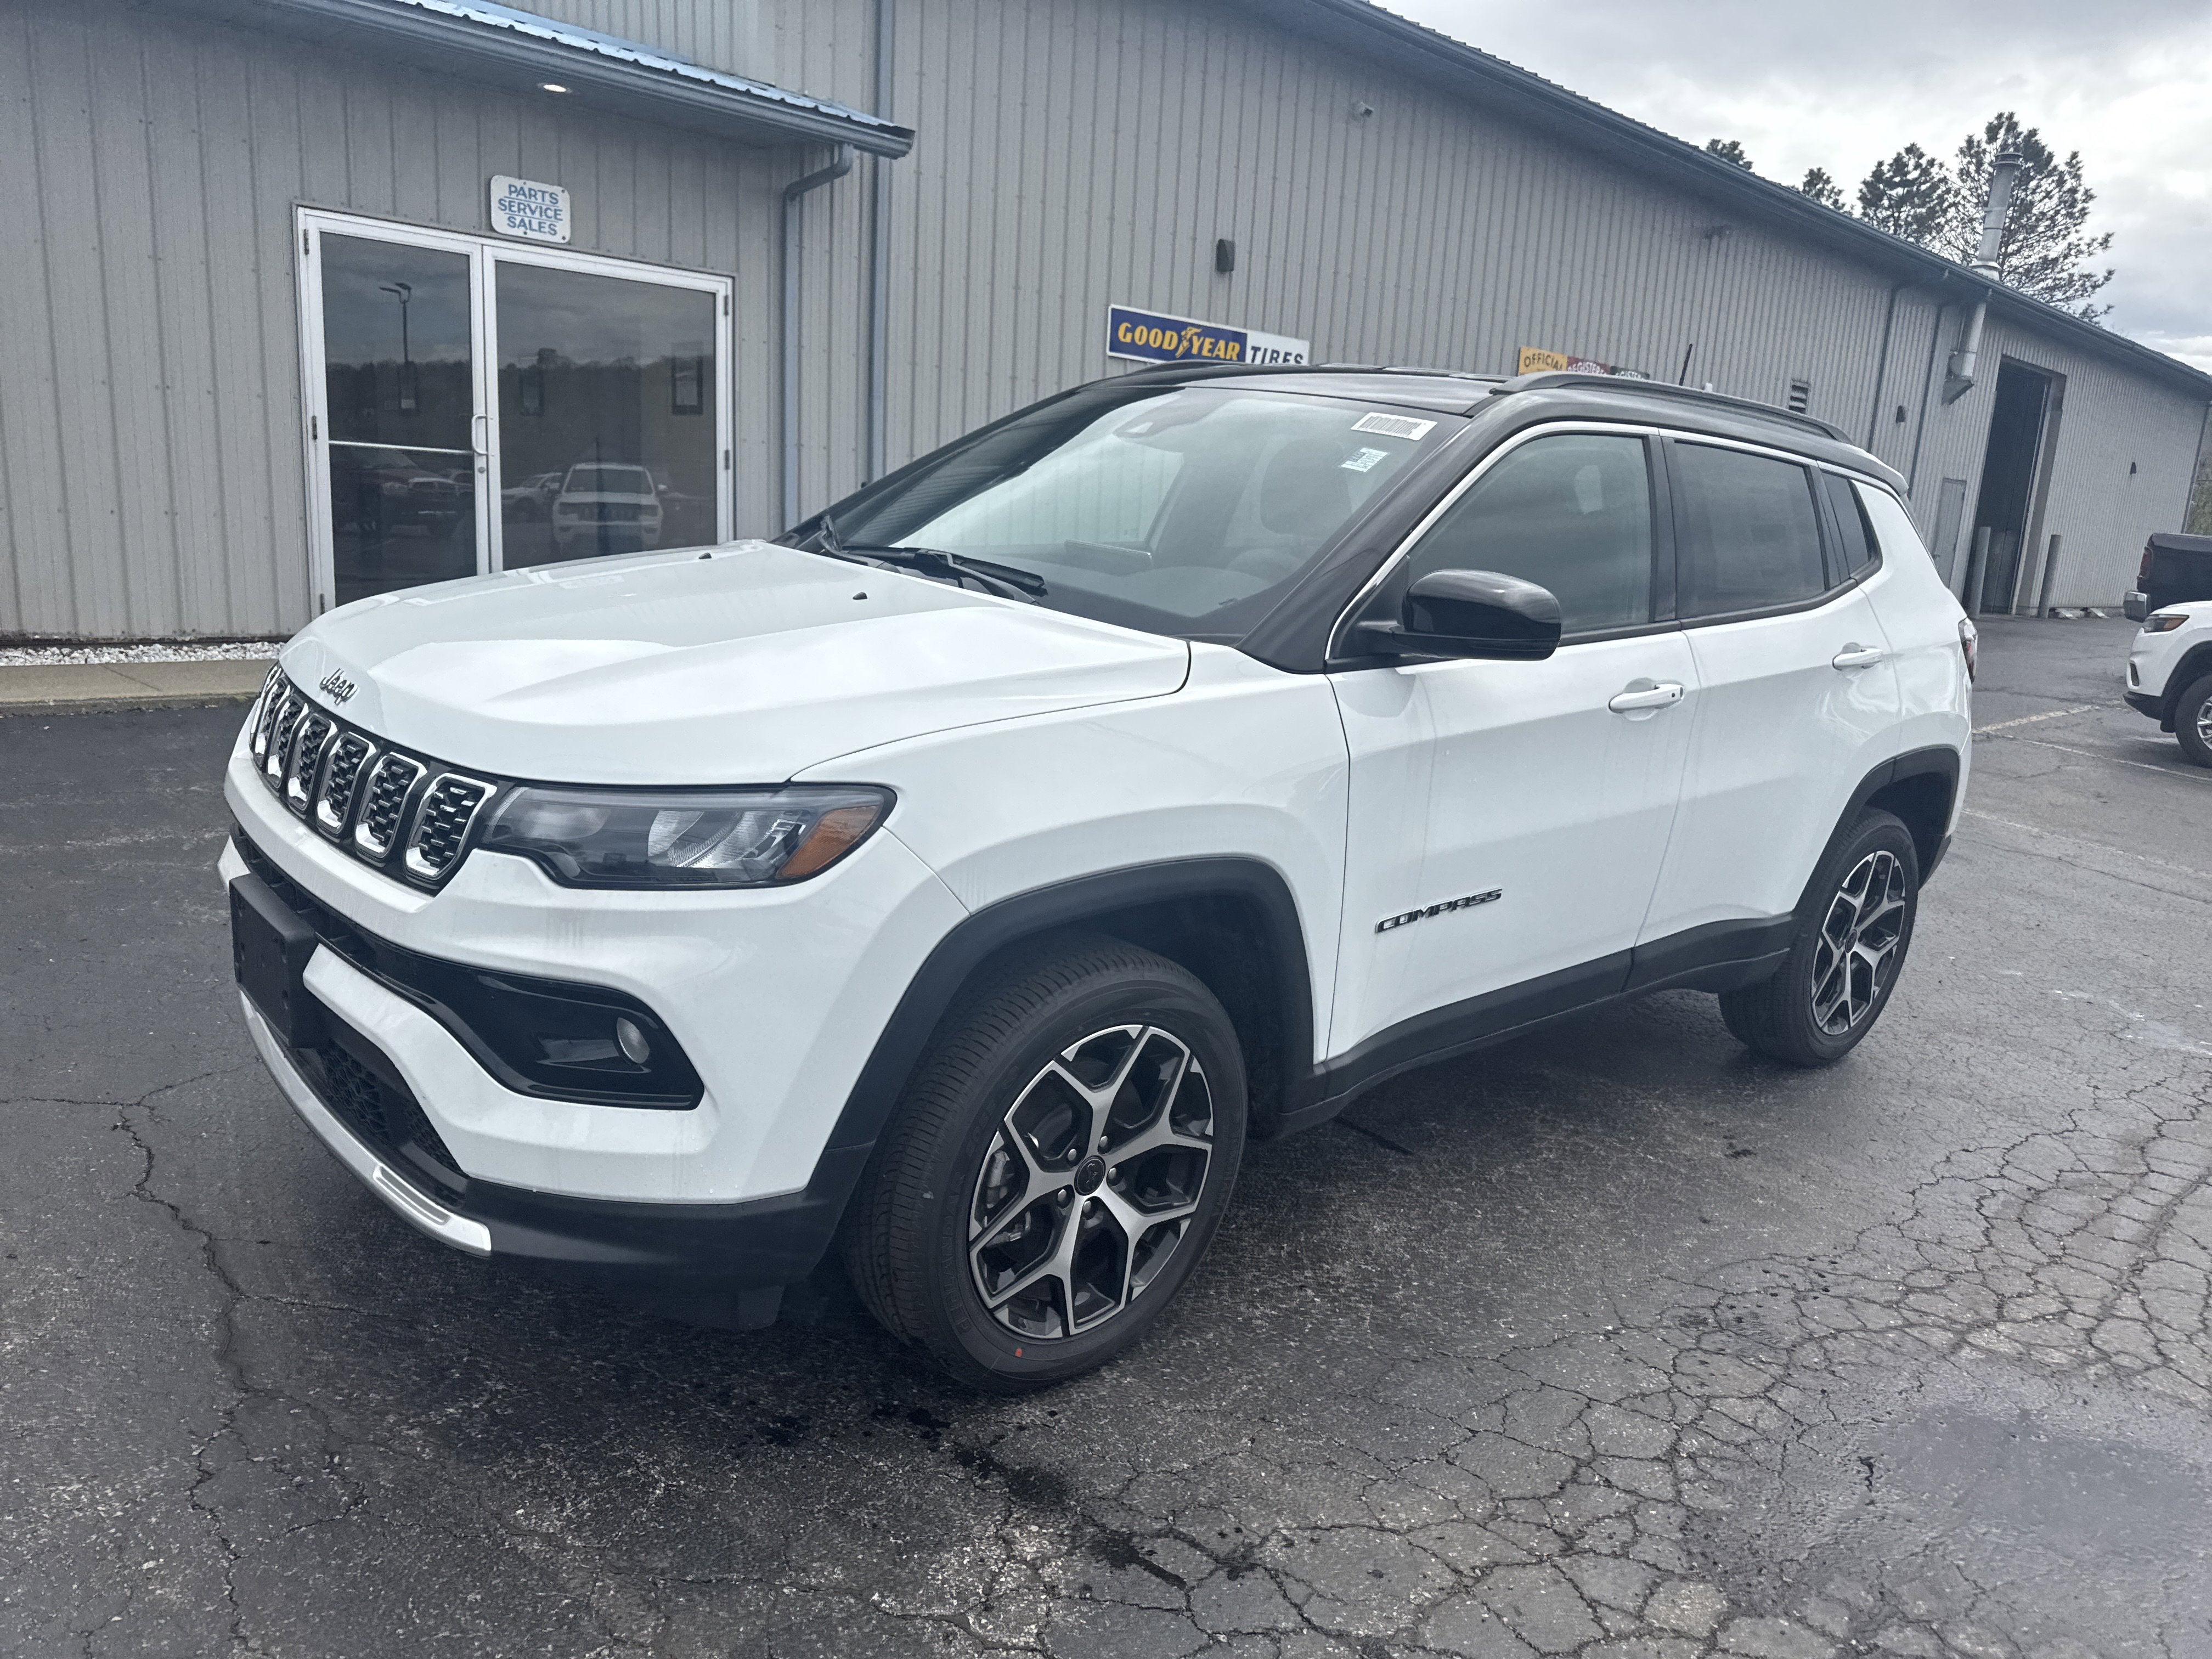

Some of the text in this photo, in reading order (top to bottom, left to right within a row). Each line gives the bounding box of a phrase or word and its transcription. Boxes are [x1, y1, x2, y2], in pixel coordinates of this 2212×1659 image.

[498, 198, 563, 221] SERVICE
[508, 184, 558, 205] PARTS
[507, 216, 557, 235] SALES
[1118, 323, 1303, 364] GOODYEAR TIRES
[319, 668, 359, 706] Jeep
[1375, 887, 1502, 933] COMPASS
